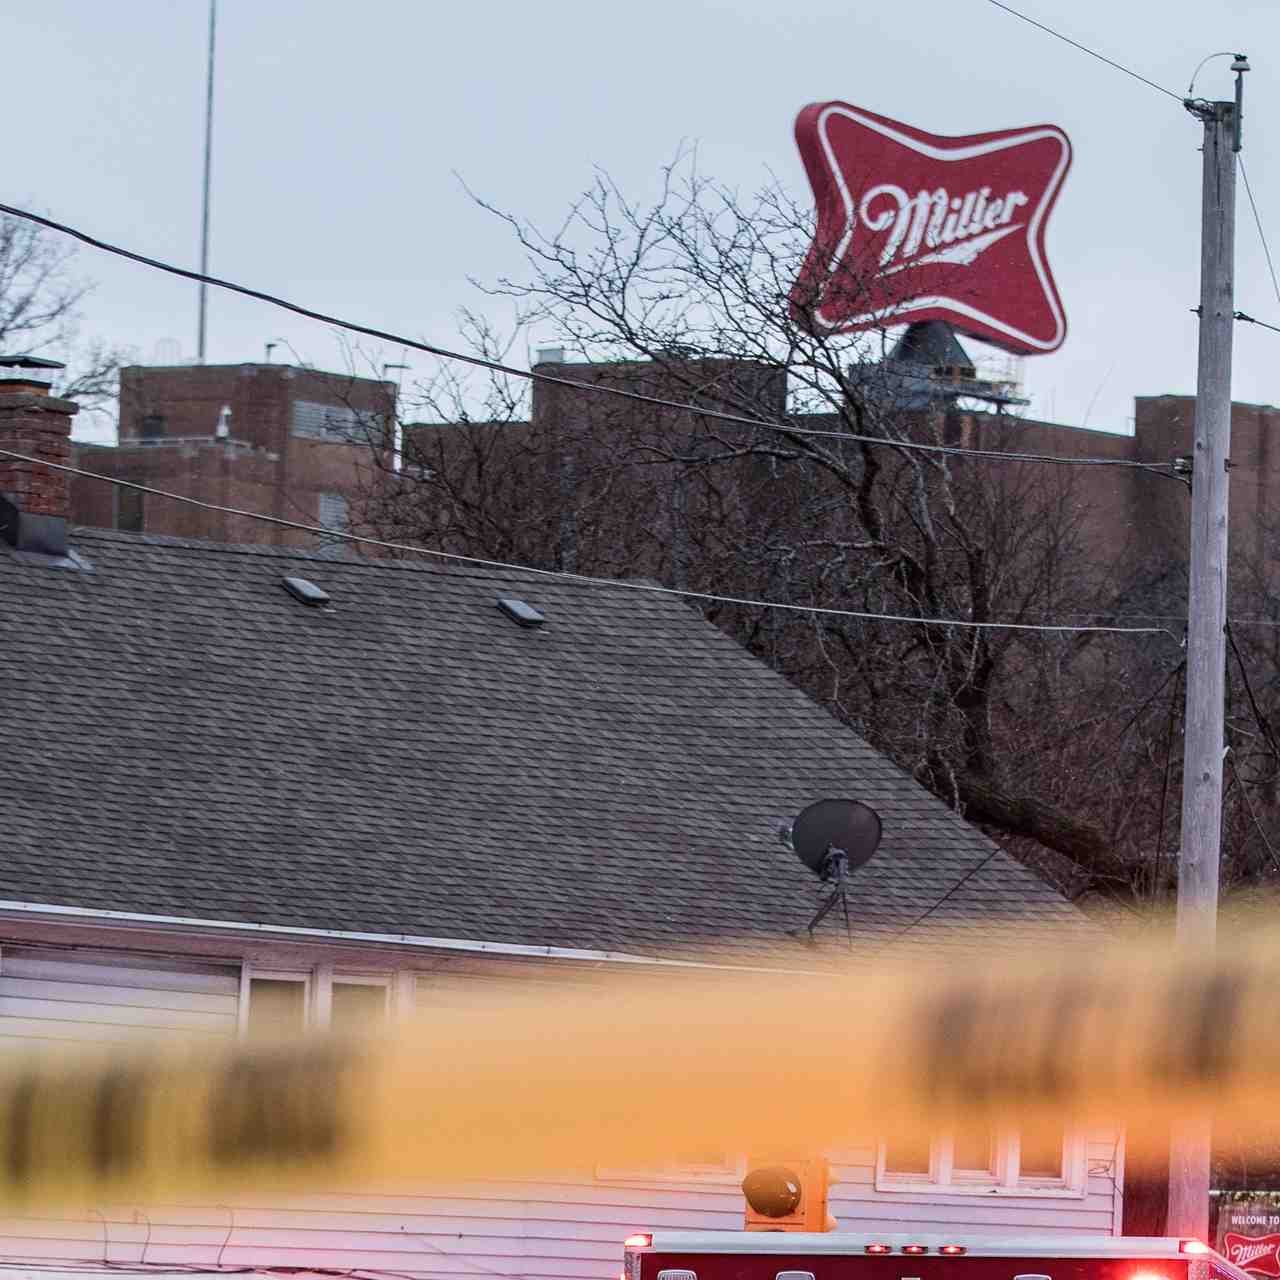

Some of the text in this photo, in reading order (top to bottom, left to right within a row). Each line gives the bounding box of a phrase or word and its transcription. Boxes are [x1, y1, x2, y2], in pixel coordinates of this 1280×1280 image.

[860, 184, 1028, 267] Miller
[1231, 1215, 1280, 1225] WELCOME TO
[1231, 1243, 1276, 1265] Miller
